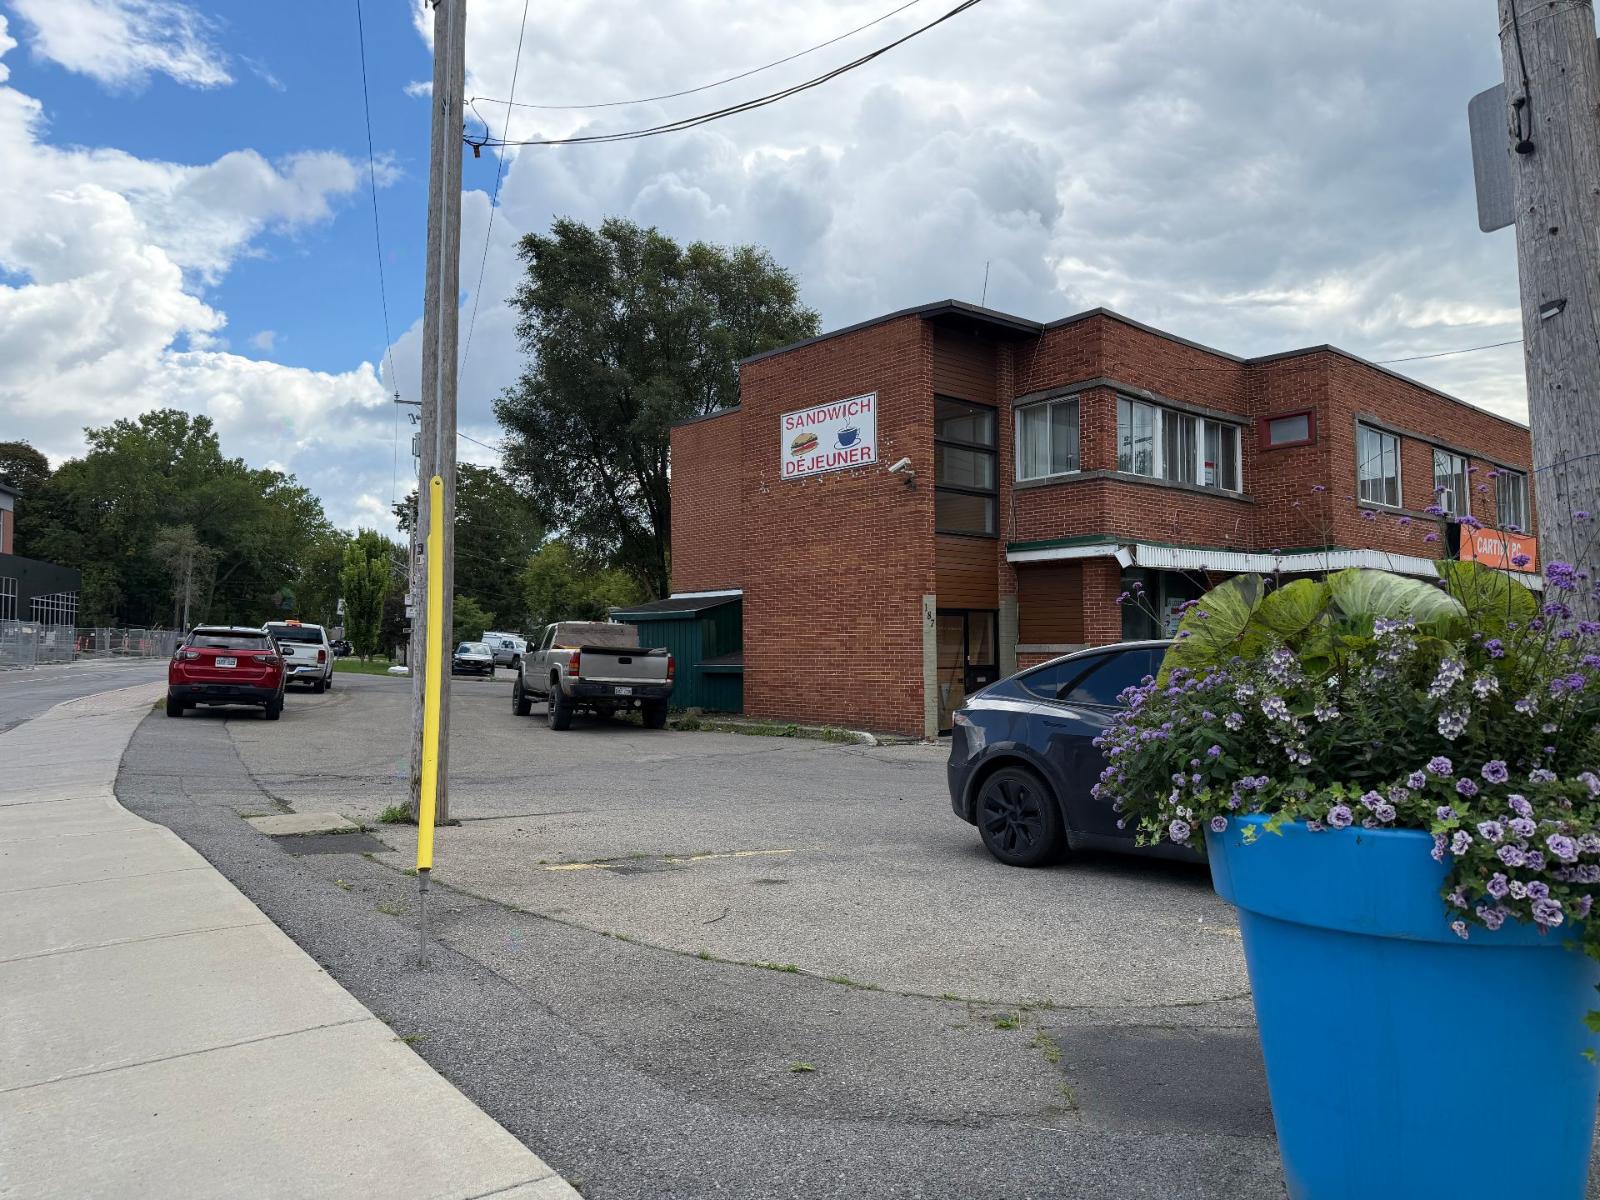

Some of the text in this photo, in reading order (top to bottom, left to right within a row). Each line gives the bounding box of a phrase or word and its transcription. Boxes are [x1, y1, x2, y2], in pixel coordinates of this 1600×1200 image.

[785, 398, 871, 430] SANDWICH
[786, 446, 871, 475] DÉJEUNER
[925, 603, 934, 627] 187
